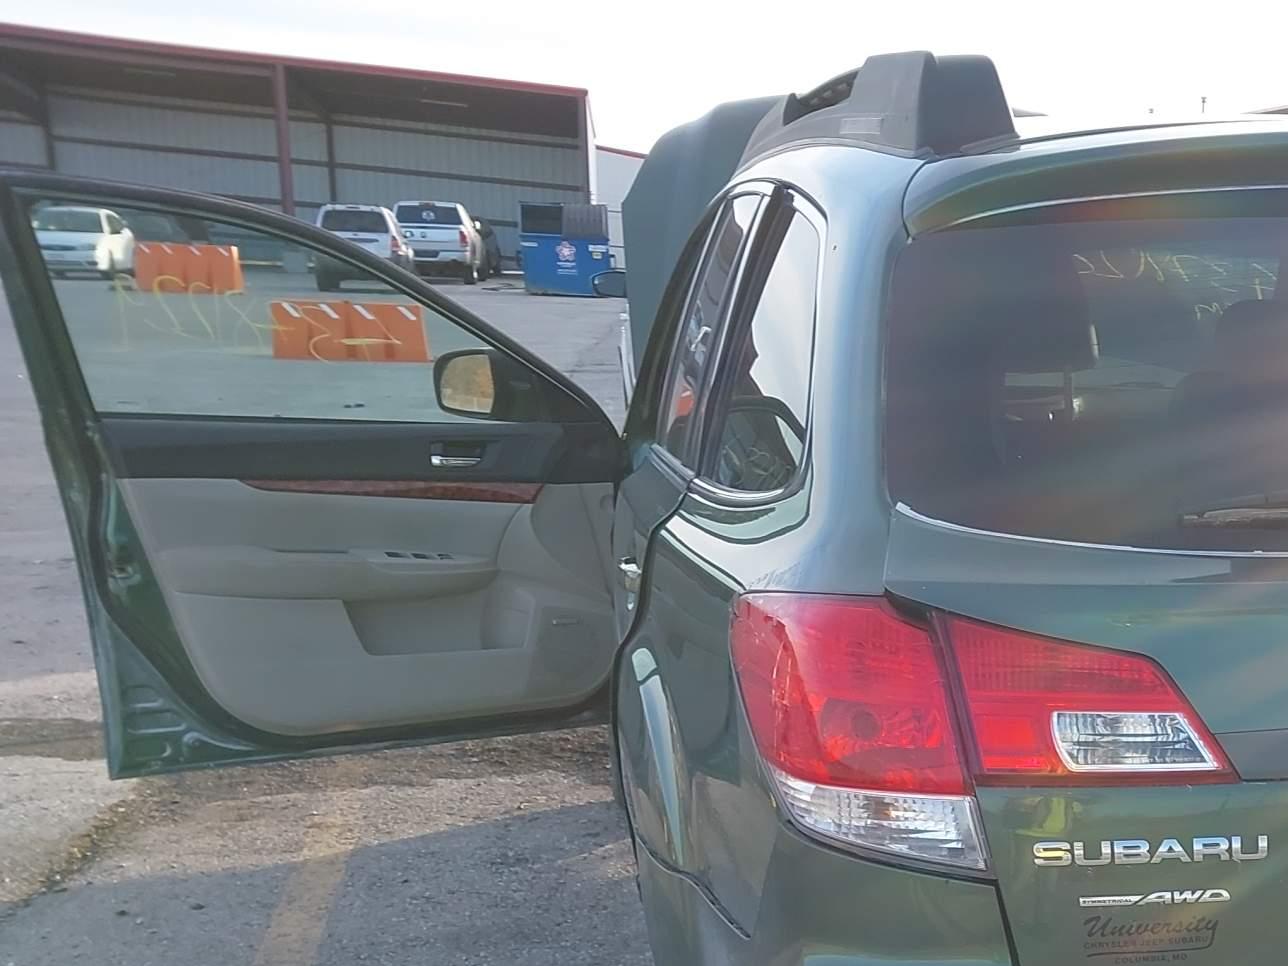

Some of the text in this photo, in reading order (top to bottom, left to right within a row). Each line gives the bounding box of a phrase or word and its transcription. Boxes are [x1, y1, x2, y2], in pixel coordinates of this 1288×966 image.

[1032, 835, 1269, 867] SUBARU
[1136, 889, 1231, 905] AWD
[1083, 915, 1219, 940] University
[1168, 935, 1208, 945] SUBARU
